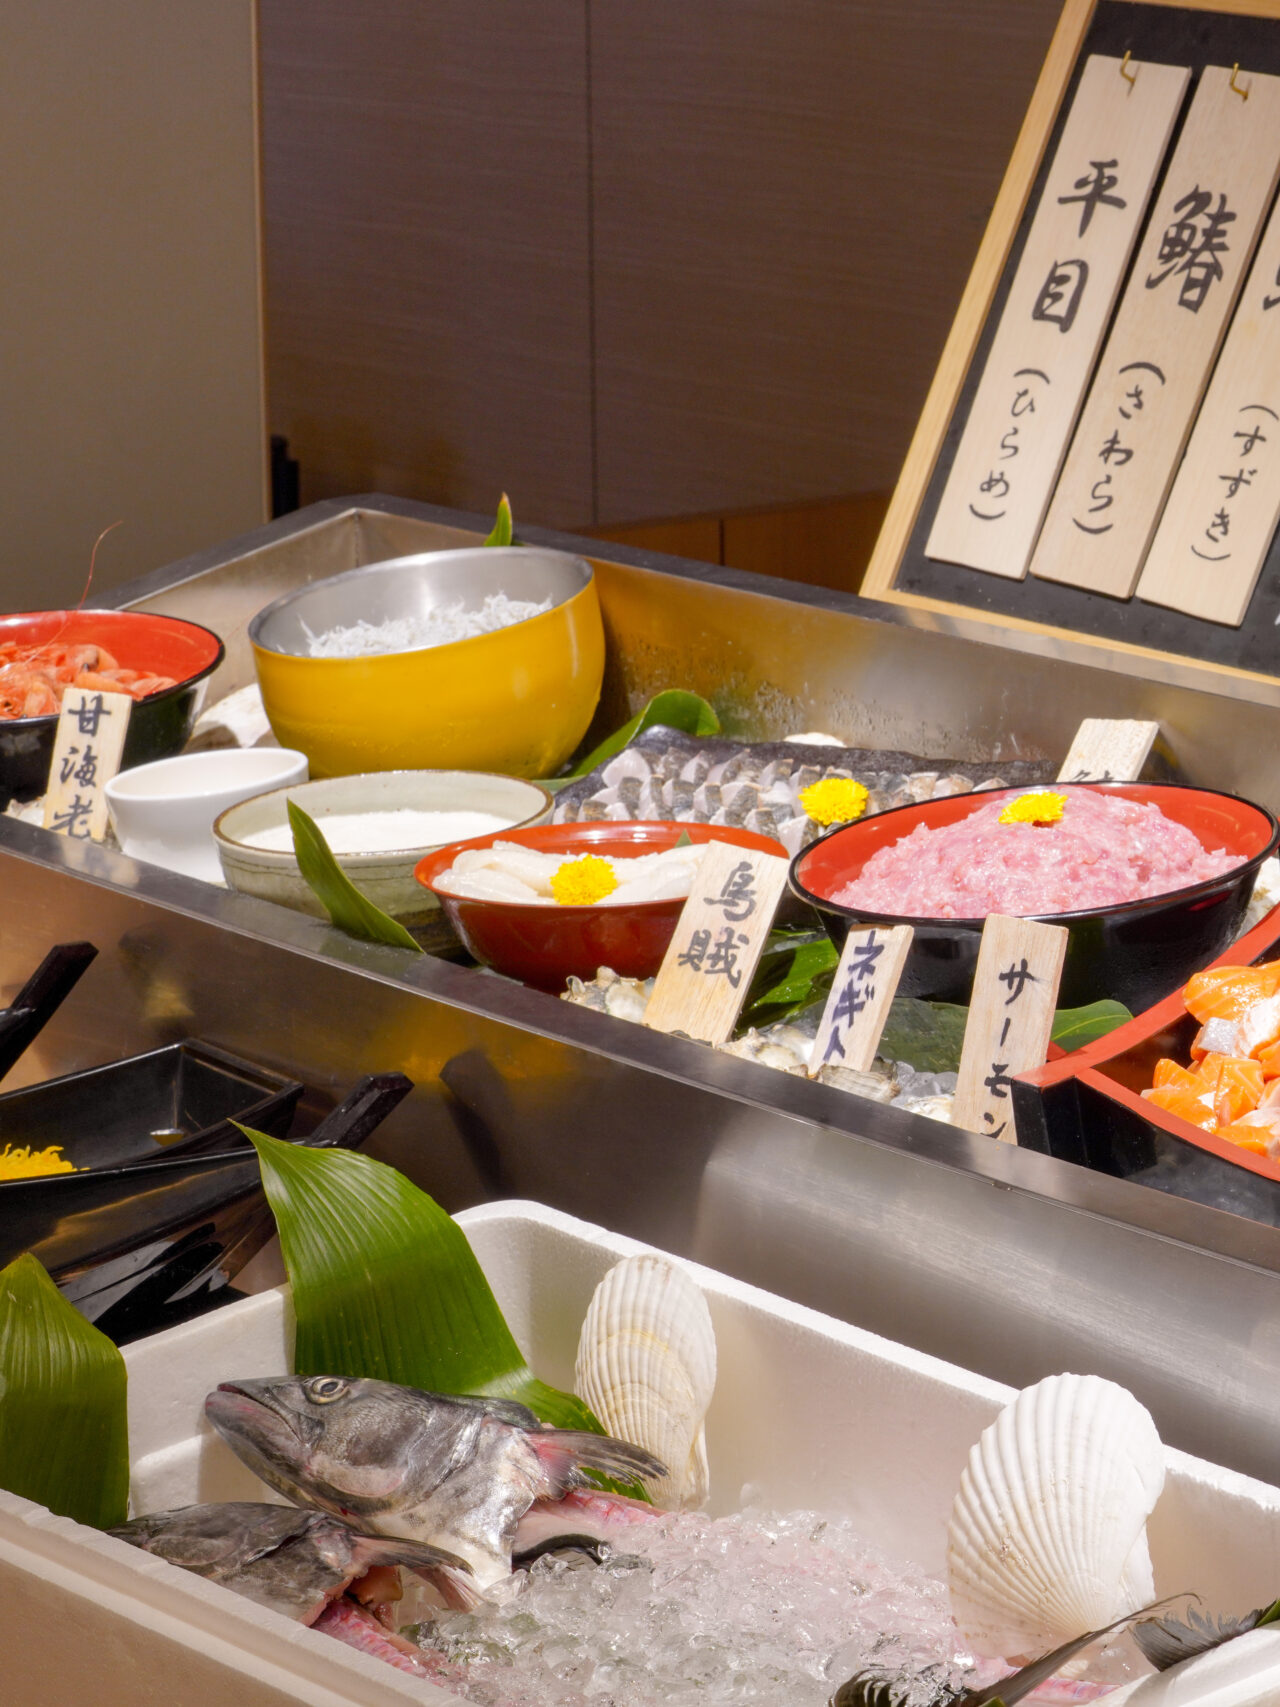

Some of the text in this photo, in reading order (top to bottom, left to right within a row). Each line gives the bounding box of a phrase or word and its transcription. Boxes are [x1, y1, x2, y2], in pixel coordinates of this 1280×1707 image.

[50, 693, 111, 839] 甘海老
[979, 957, 1036, 1139] サーモン
